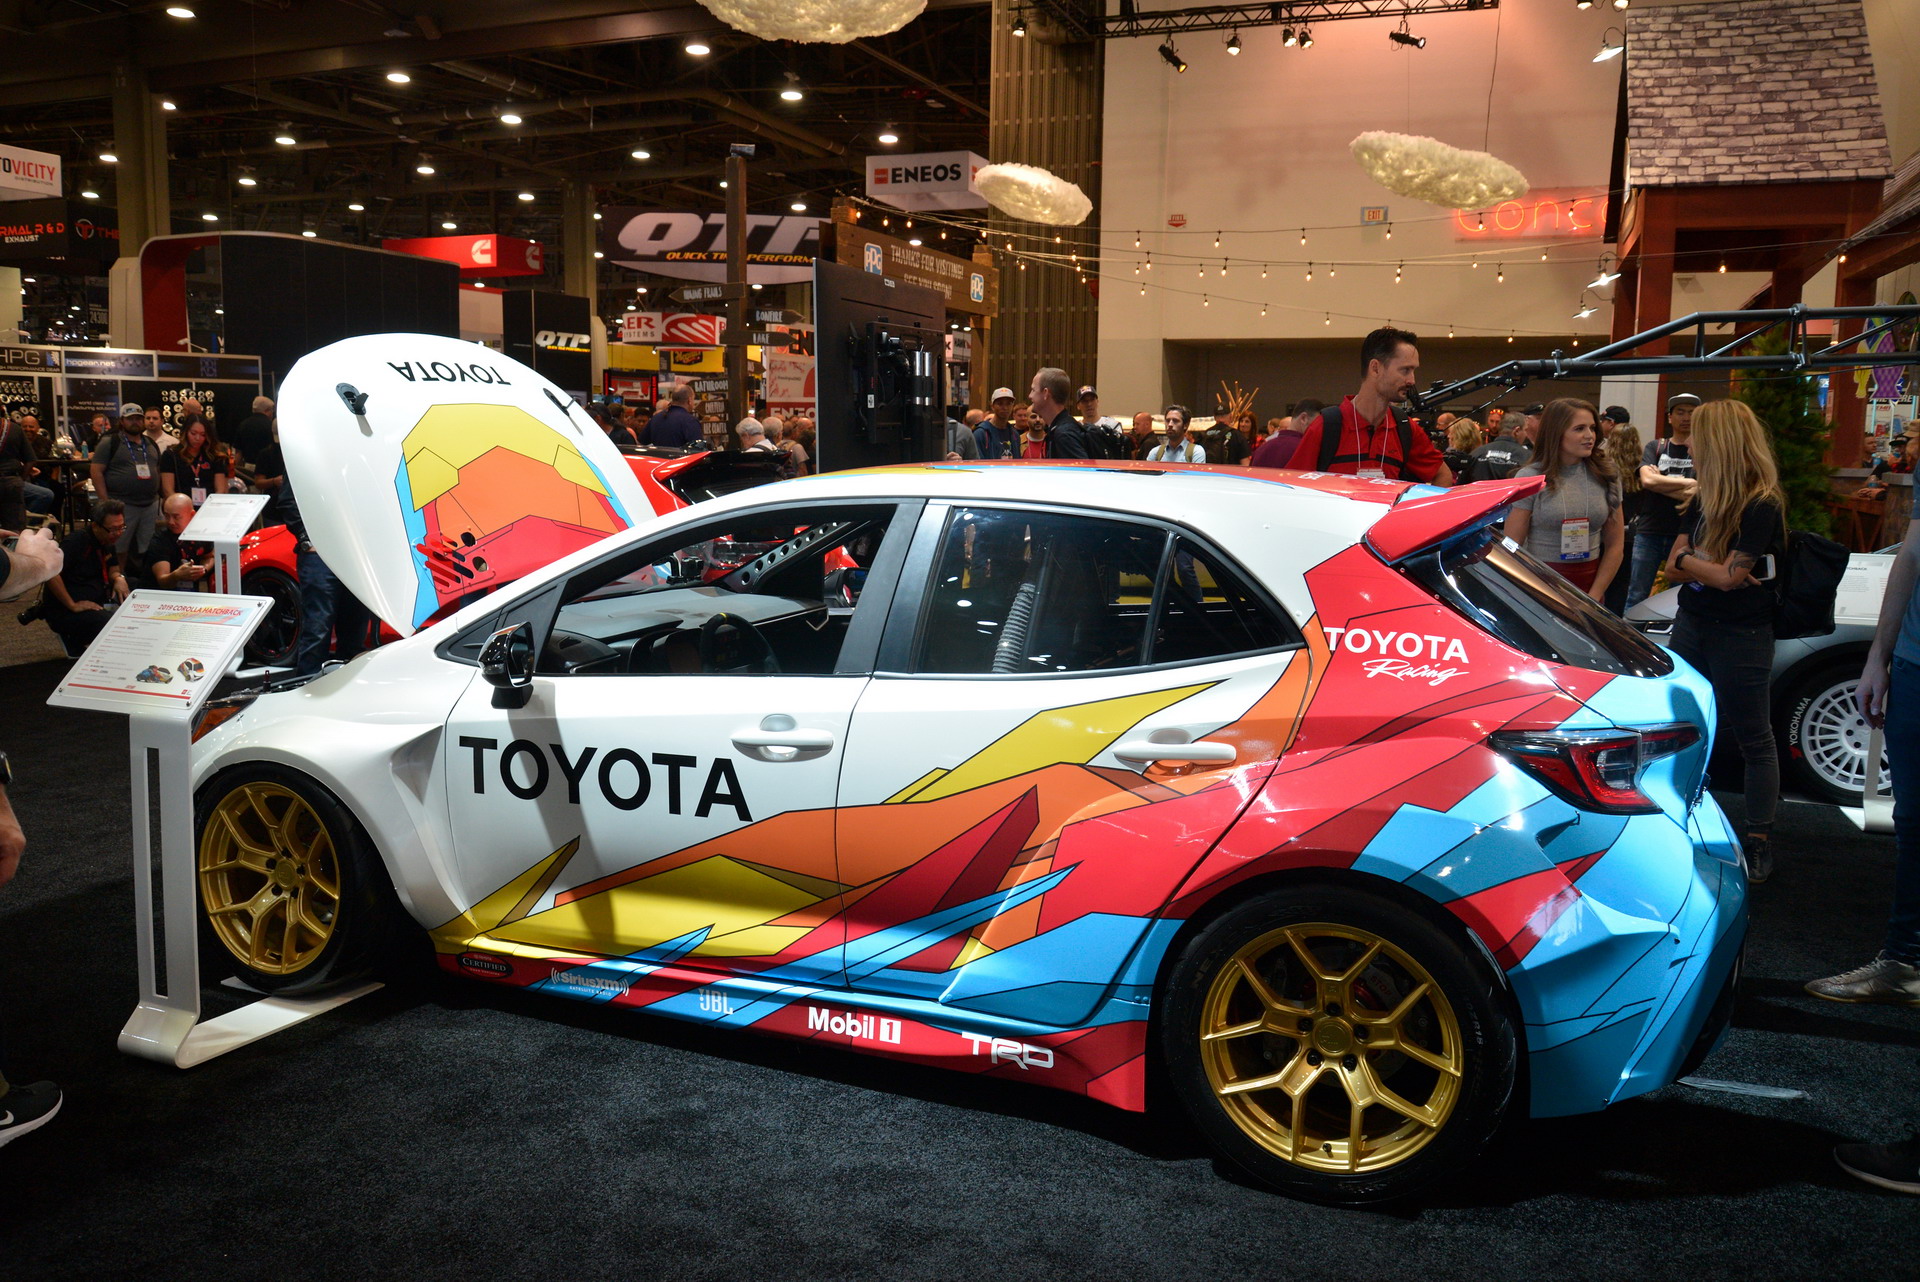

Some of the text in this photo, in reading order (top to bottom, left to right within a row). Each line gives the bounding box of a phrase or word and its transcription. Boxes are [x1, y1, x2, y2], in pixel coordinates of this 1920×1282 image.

[0, 157, 55, 181] OVICITY
[892, 163, 962, 184] ENEOS
[1367, 209, 1381, 220] EXIT
[35, 223, 44, 234] R
[46, 223, 54, 233] &
[56, 222, 65, 233] D
[4, 235, 39, 243] EXHAUST
[666, 252, 708, 261] QUICK
[891, 245, 964, 280] THANKS FOR VISITING!
[755, 310, 783, 323] BONFIRE
[535, 330, 591, 348] QTP
[752, 333, 770, 344] LAKE
[65, 359, 116, 368] hpgear.net
[387, 361, 512, 386] TOYOTA
[694, 379, 729, 393] BATHROOM
[172, 605, 204, 613] COROLLA
[203, 606, 242, 616] HATCHBACK
[1323, 626, 1469, 664] TOYOTA
[1361, 658, 1470, 687] Racing
[1789, 696, 1812, 746] YOKOHAMA
[459, 735, 754, 823] TOYOTA
[462, 957, 507, 972] CERTIFIED
[569, 985, 595, 994] SATELLITE
[699, 988, 734, 1015] JBL
[808, 1006, 875, 1040] Mobil
[961, 1031, 1054, 1070] TRD
